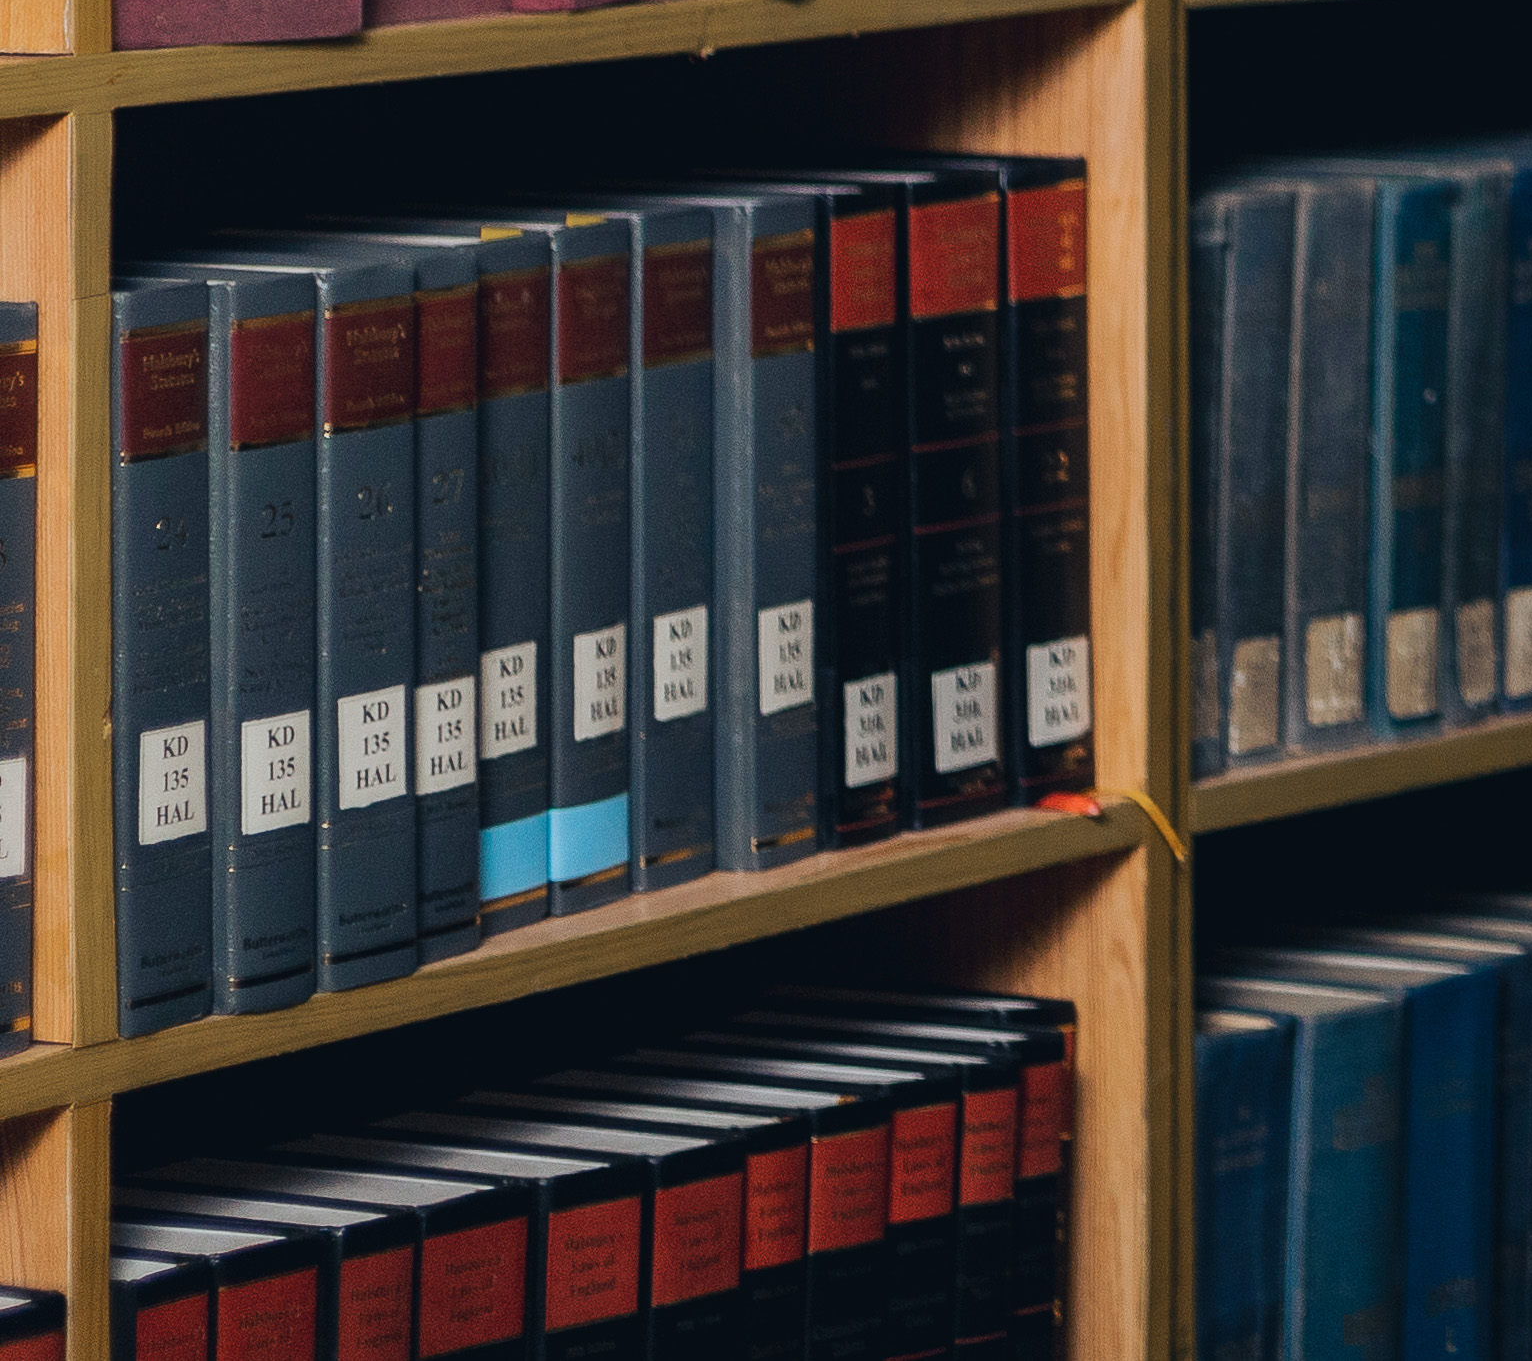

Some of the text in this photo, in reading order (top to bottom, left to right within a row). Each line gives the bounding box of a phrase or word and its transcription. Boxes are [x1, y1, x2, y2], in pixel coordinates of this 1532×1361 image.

[260, 500, 296, 540] 25
[499, 654, 524, 679] KD
[436, 688, 463, 712] KD
[499, 684, 524, 710] 135
[361, 699, 390, 725] KD
[267, 724, 296, 751] KD
[436, 718, 463, 745] 135
[493, 714, 530, 742] HAL
[161, 734, 190, 761] KD
[362, 729, 391, 757] 135
[268, 755, 297, 782] 135
[355, 762, 397, 791] HAL
[430, 750, 468, 778] HAL
[161, 766, 190, 794] 135
[155, 799, 196, 828] HAL
[260, 787, 301, 816] HAL
